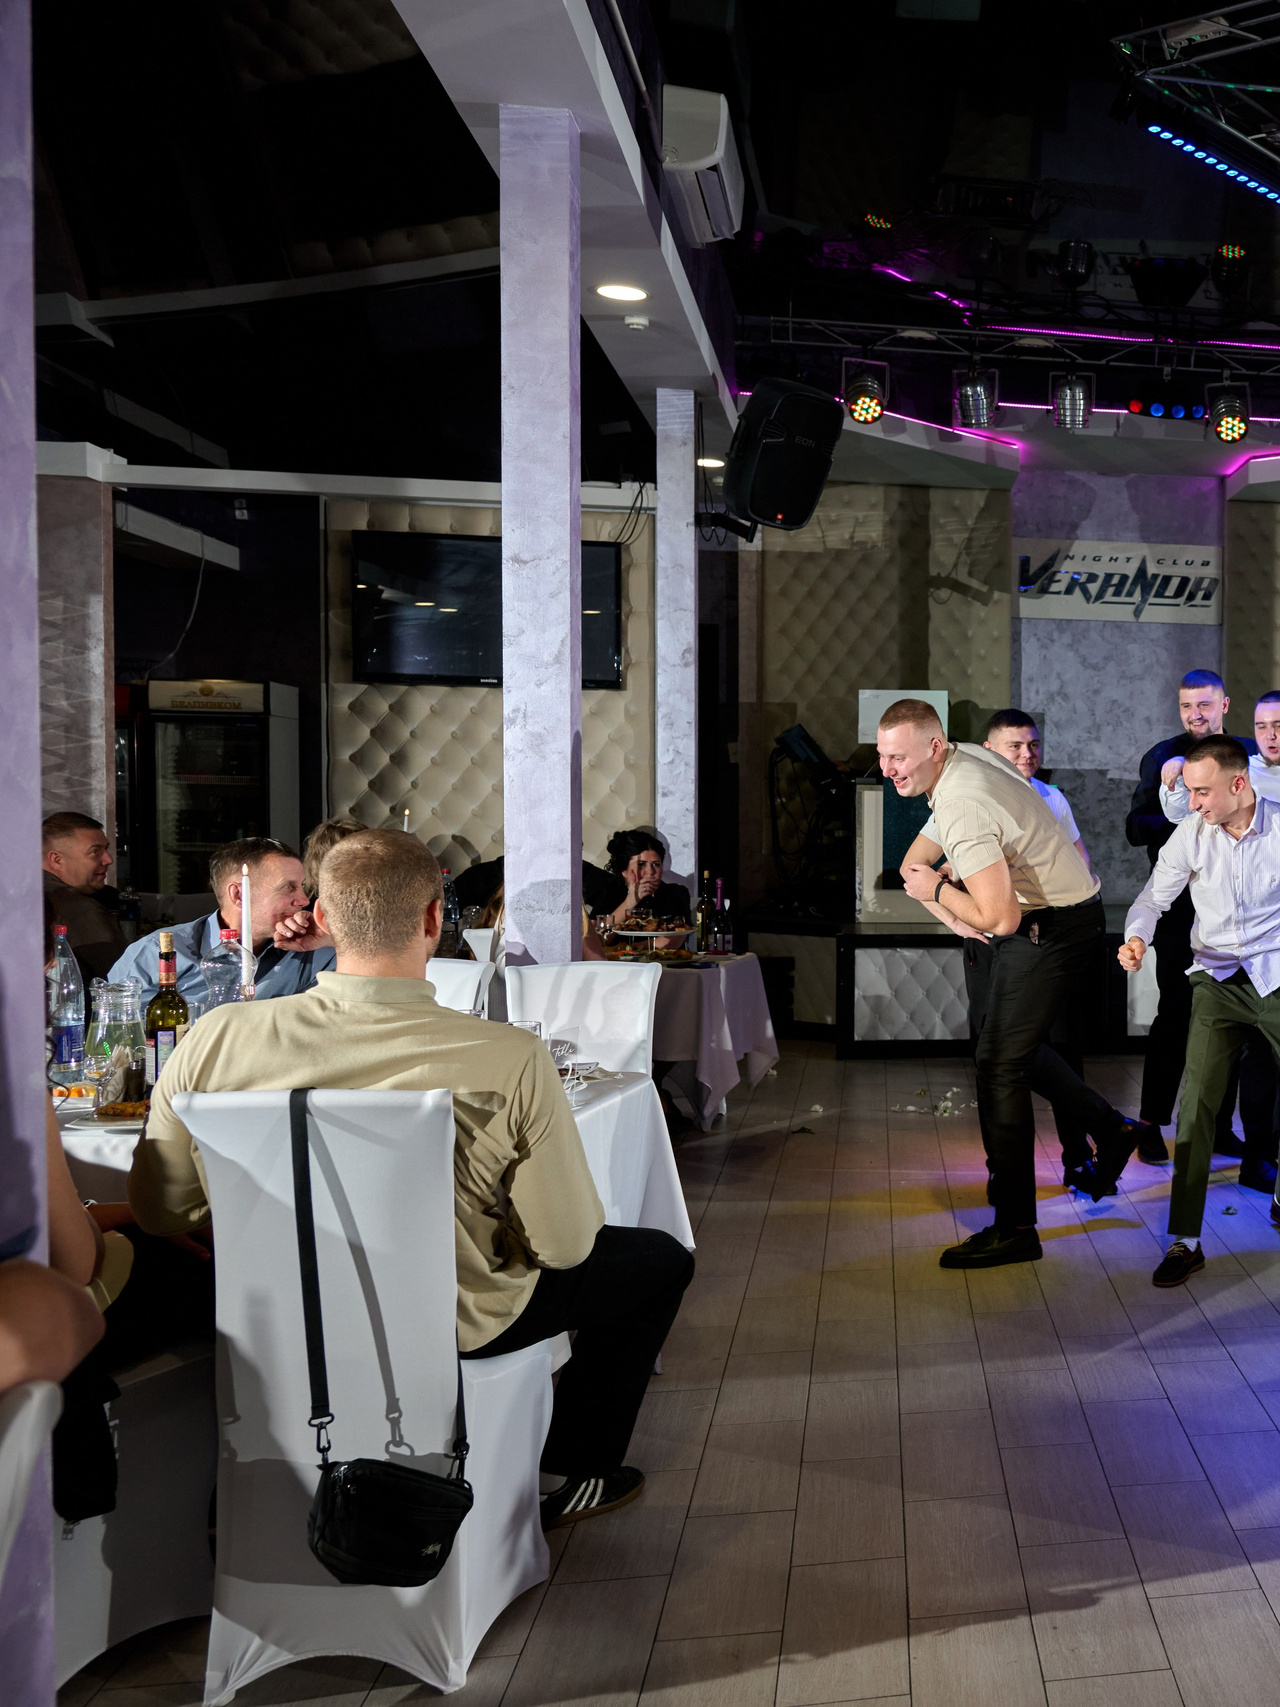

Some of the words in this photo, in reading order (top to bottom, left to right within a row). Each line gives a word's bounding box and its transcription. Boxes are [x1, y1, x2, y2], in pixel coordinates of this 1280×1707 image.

[795, 435, 816, 448] EON
[1063, 553, 1134, 564] NIGHT
[1156, 557, 1211, 567] CLUB
[1018, 547, 1220, 622] VERANDA
